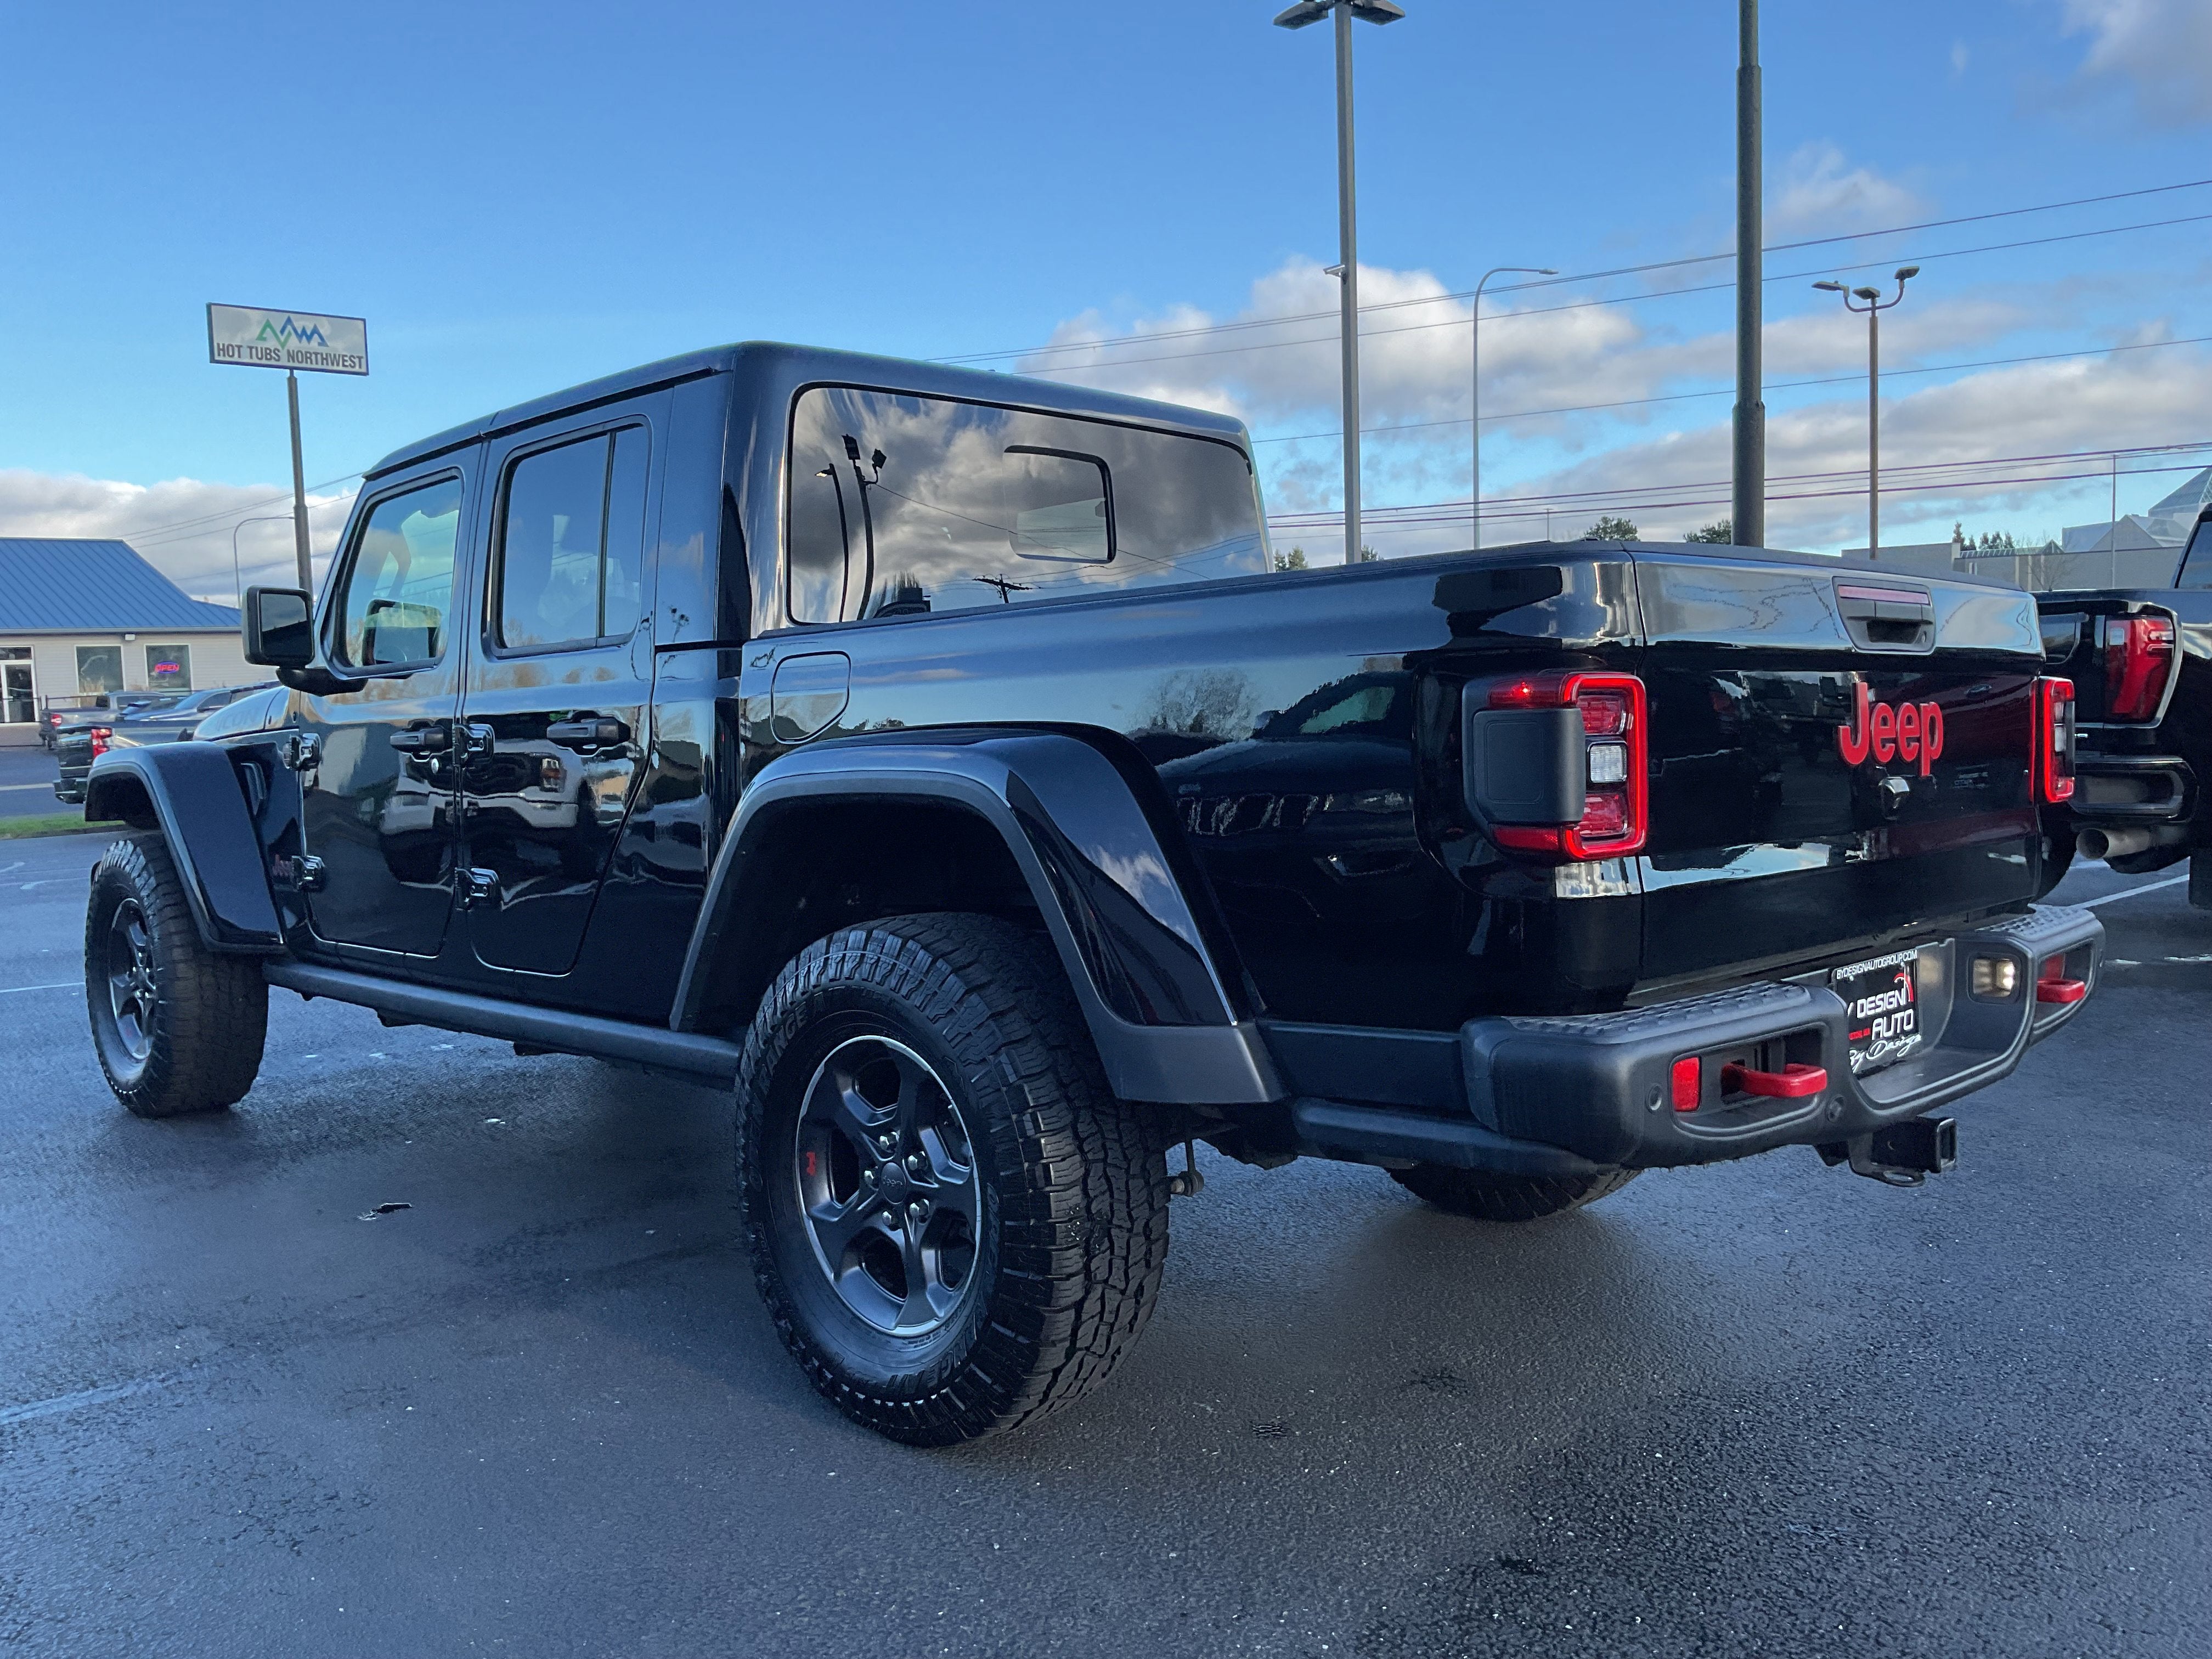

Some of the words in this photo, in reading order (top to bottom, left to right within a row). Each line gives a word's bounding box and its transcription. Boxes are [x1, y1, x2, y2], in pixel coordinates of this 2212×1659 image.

[216, 342, 243, 358] HOT
[247, 346, 280, 362] TUBS
[287, 349, 364, 369] NORTHWEST
[155, 664, 179, 672] OPEN
[1838, 682, 1943, 776] Jeep
[1837, 950, 1917, 979] BYDESIGNAUTOGROUP.COM
[1857, 988, 1906, 1018] DESIGN
[1872, 1009, 1914, 1040] AUTO
[758, 1002, 809, 1094] RANGE
